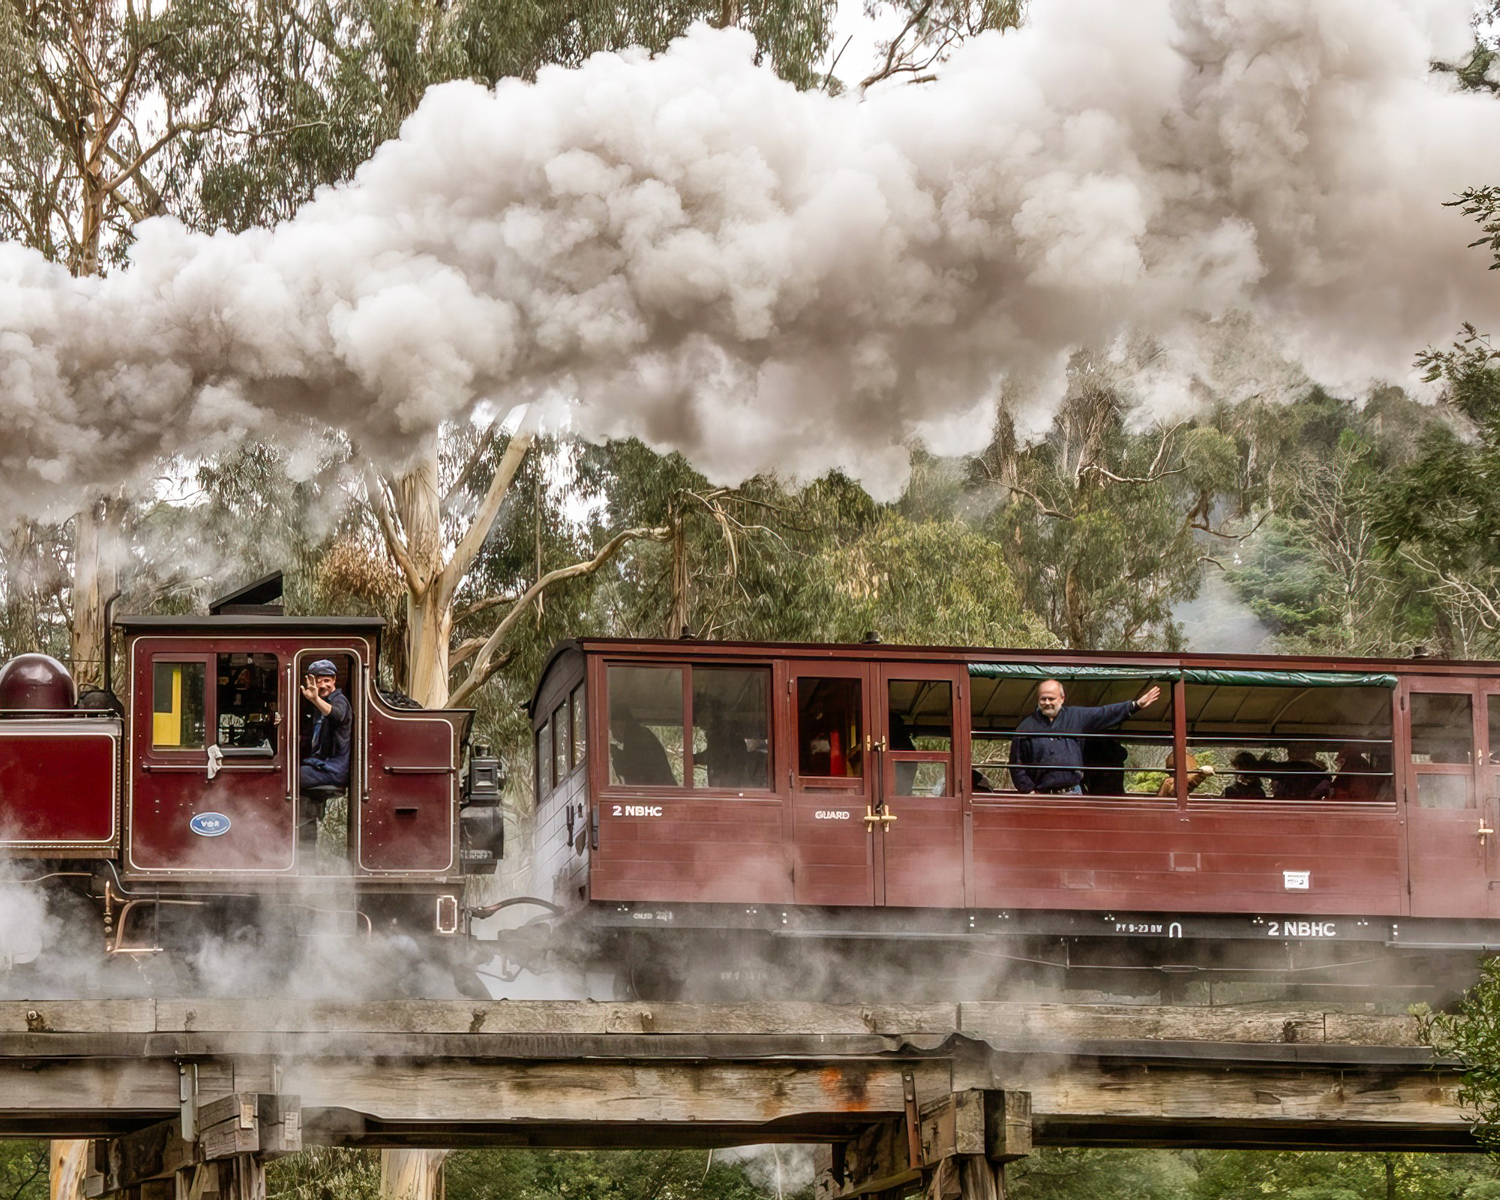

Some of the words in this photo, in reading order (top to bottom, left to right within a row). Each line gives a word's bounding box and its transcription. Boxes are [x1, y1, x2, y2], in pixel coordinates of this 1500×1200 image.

[612, 805, 623, 816] 2
[625, 805, 663, 817] NBHC
[815, 810, 850, 820] GUARD
[1268, 921, 1280, 936] 2
[1284, 921, 1337, 937] NBHC
